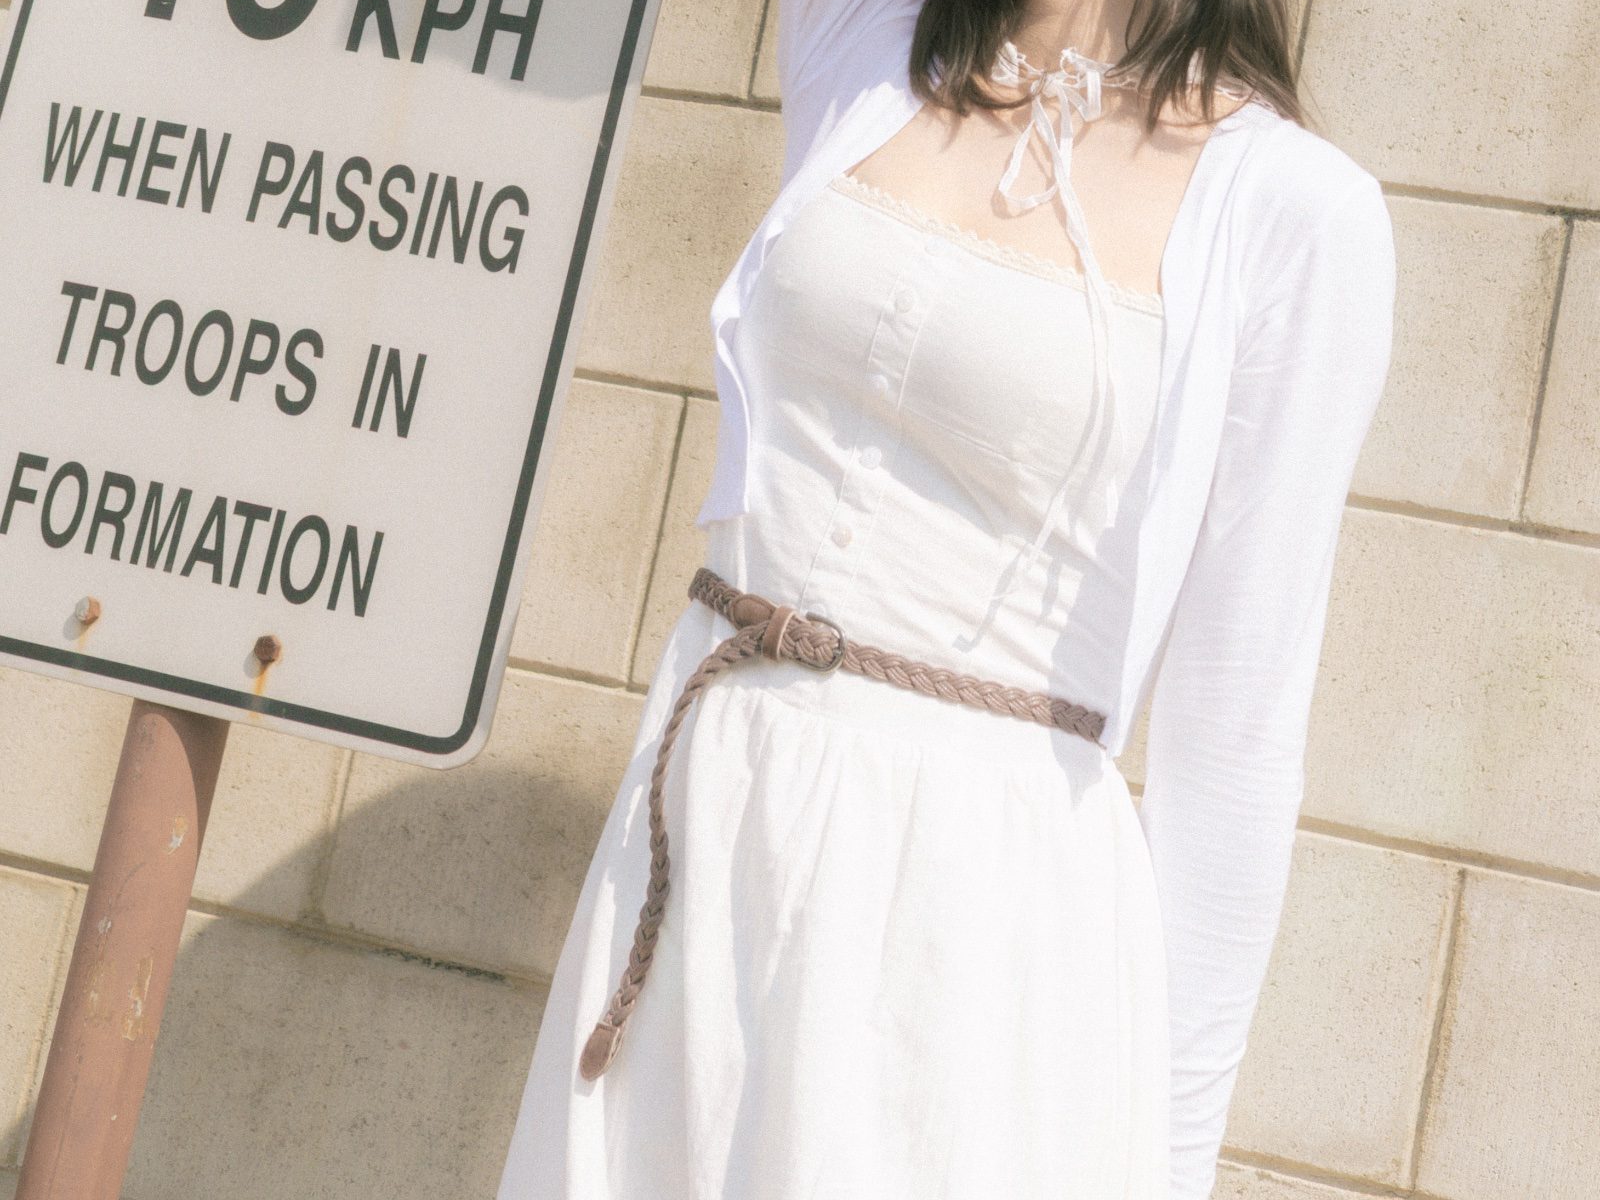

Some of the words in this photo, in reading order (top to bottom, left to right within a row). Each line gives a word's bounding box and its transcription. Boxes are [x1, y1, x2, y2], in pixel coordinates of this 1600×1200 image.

[43, 102, 232, 214] WHEN
[246, 141, 530, 274] PASSING
[56, 281, 325, 416] TROOPS
[351, 344, 427, 439] IN
[0, 452, 385, 618] FORMATION
